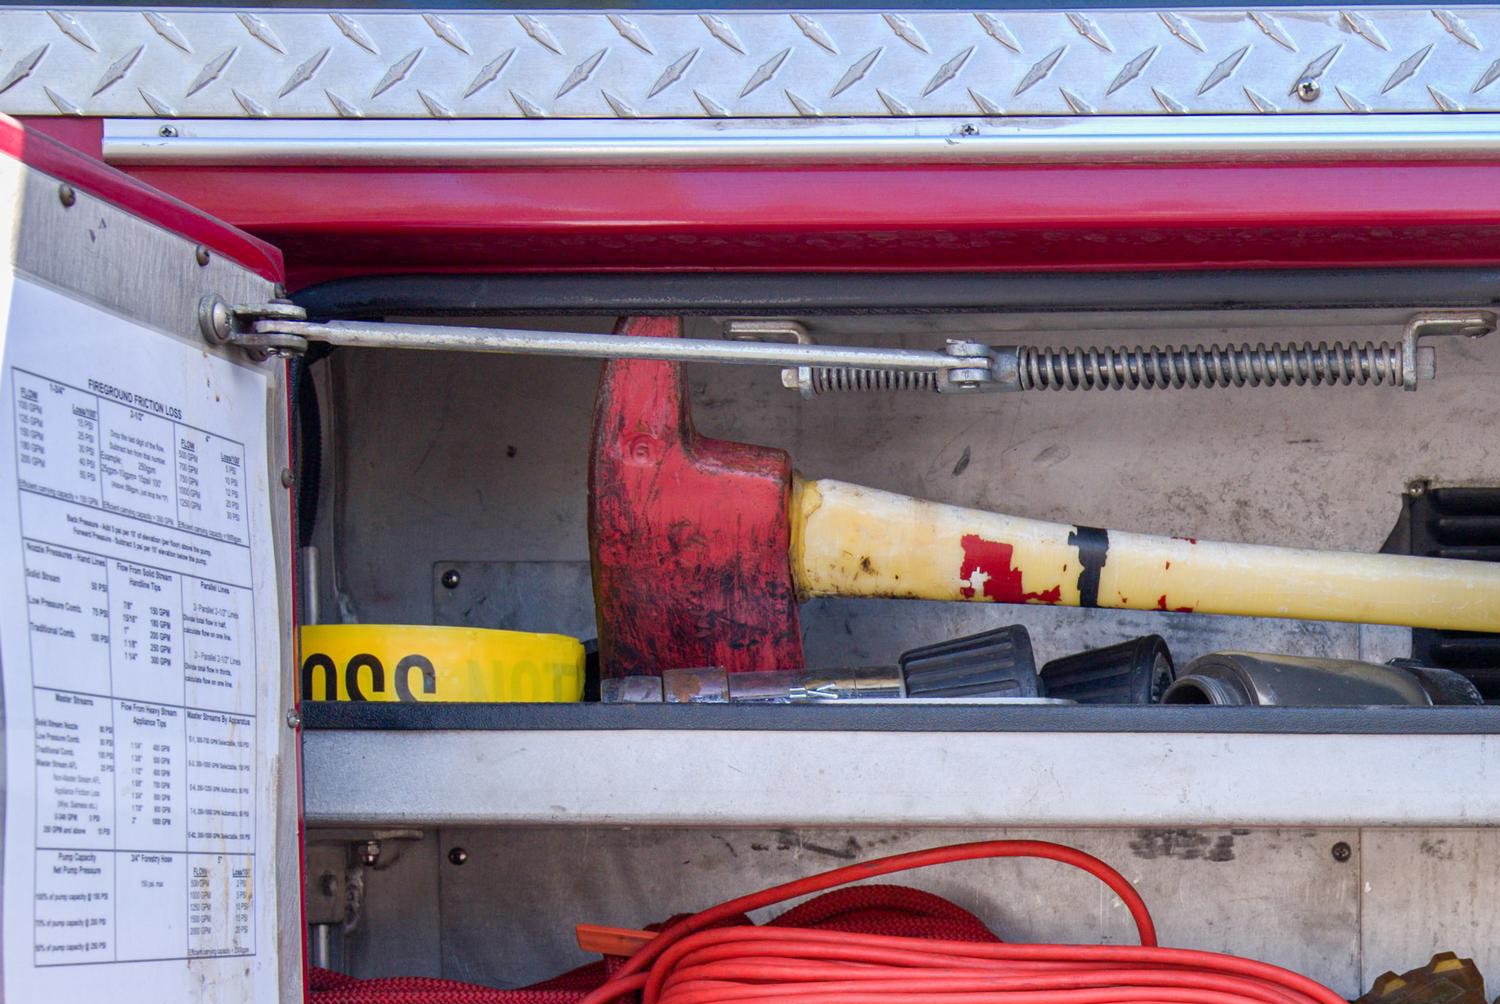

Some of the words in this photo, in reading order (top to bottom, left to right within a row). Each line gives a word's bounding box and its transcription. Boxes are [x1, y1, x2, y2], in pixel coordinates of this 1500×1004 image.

[88, 378, 133, 403] FIREGROUND
[133, 394, 165, 414] FRICTION
[166, 404, 182, 420] LOSS
